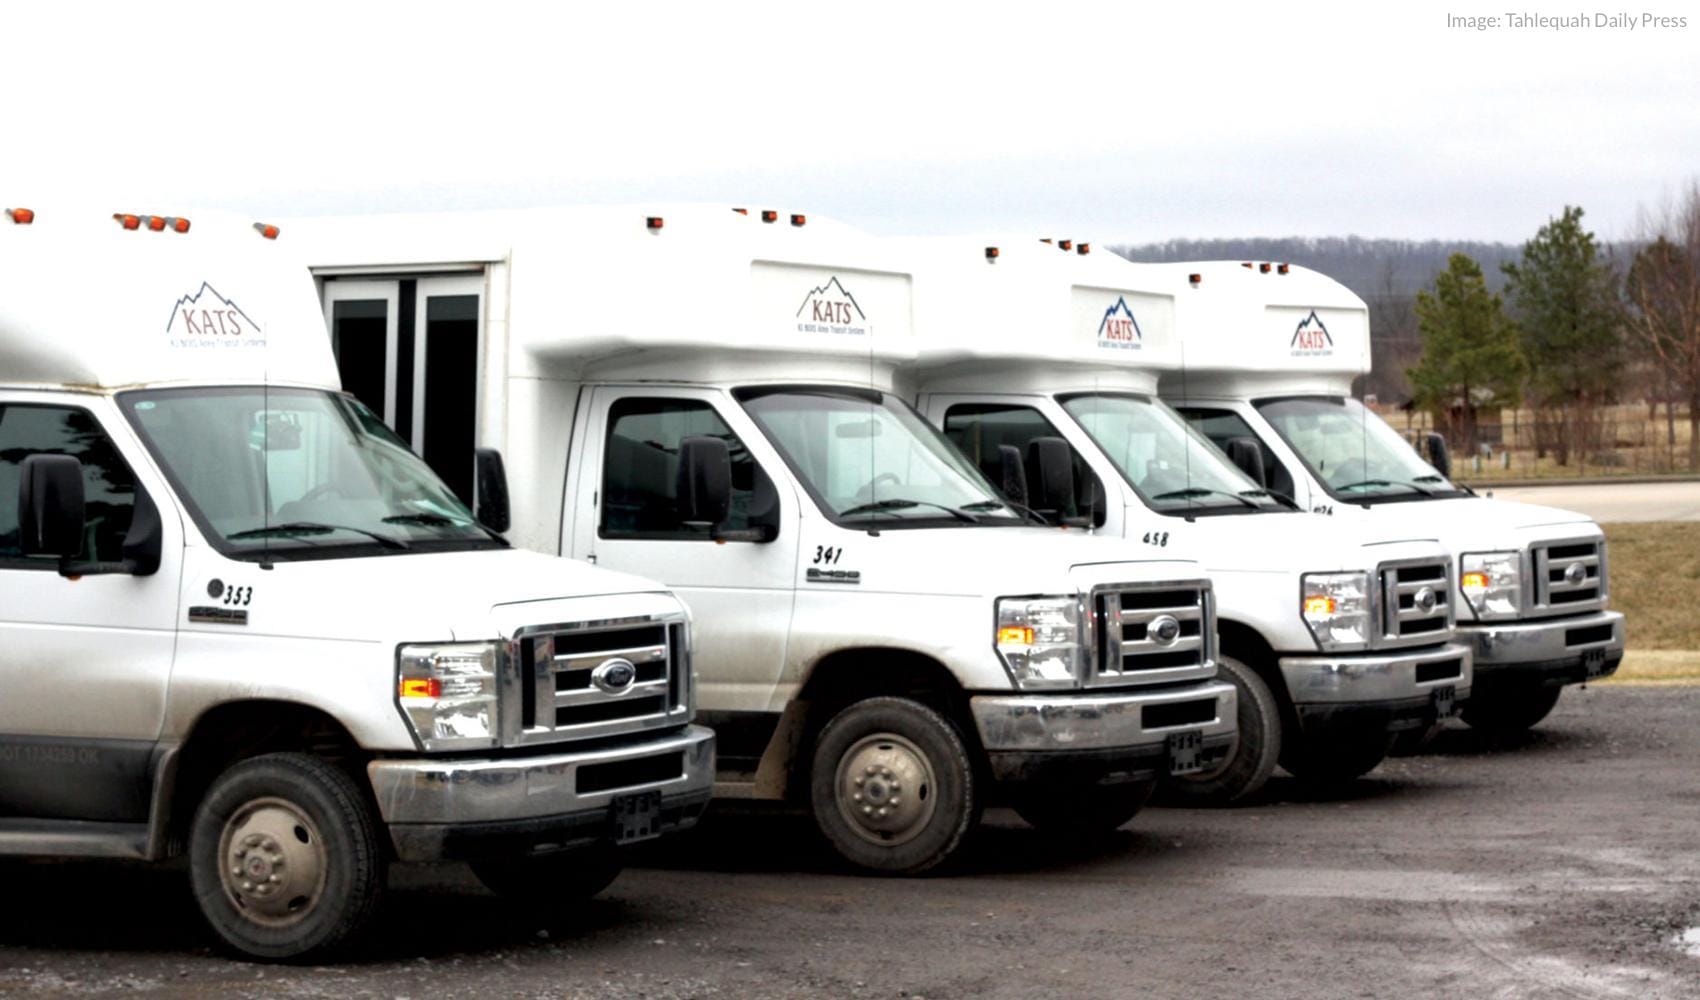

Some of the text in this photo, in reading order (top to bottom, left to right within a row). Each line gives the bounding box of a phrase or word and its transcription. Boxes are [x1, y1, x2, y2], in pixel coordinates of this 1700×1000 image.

[182, 308, 241, 336] KATS
[813, 299, 852, 325] KATS
[1106, 319, 1133, 341] KATS
[1298, 330, 1325, 349] KATS
[1142, 531, 1170, 548] 458
[813, 545, 843, 565] 341
[223, 584, 253, 606] 353
